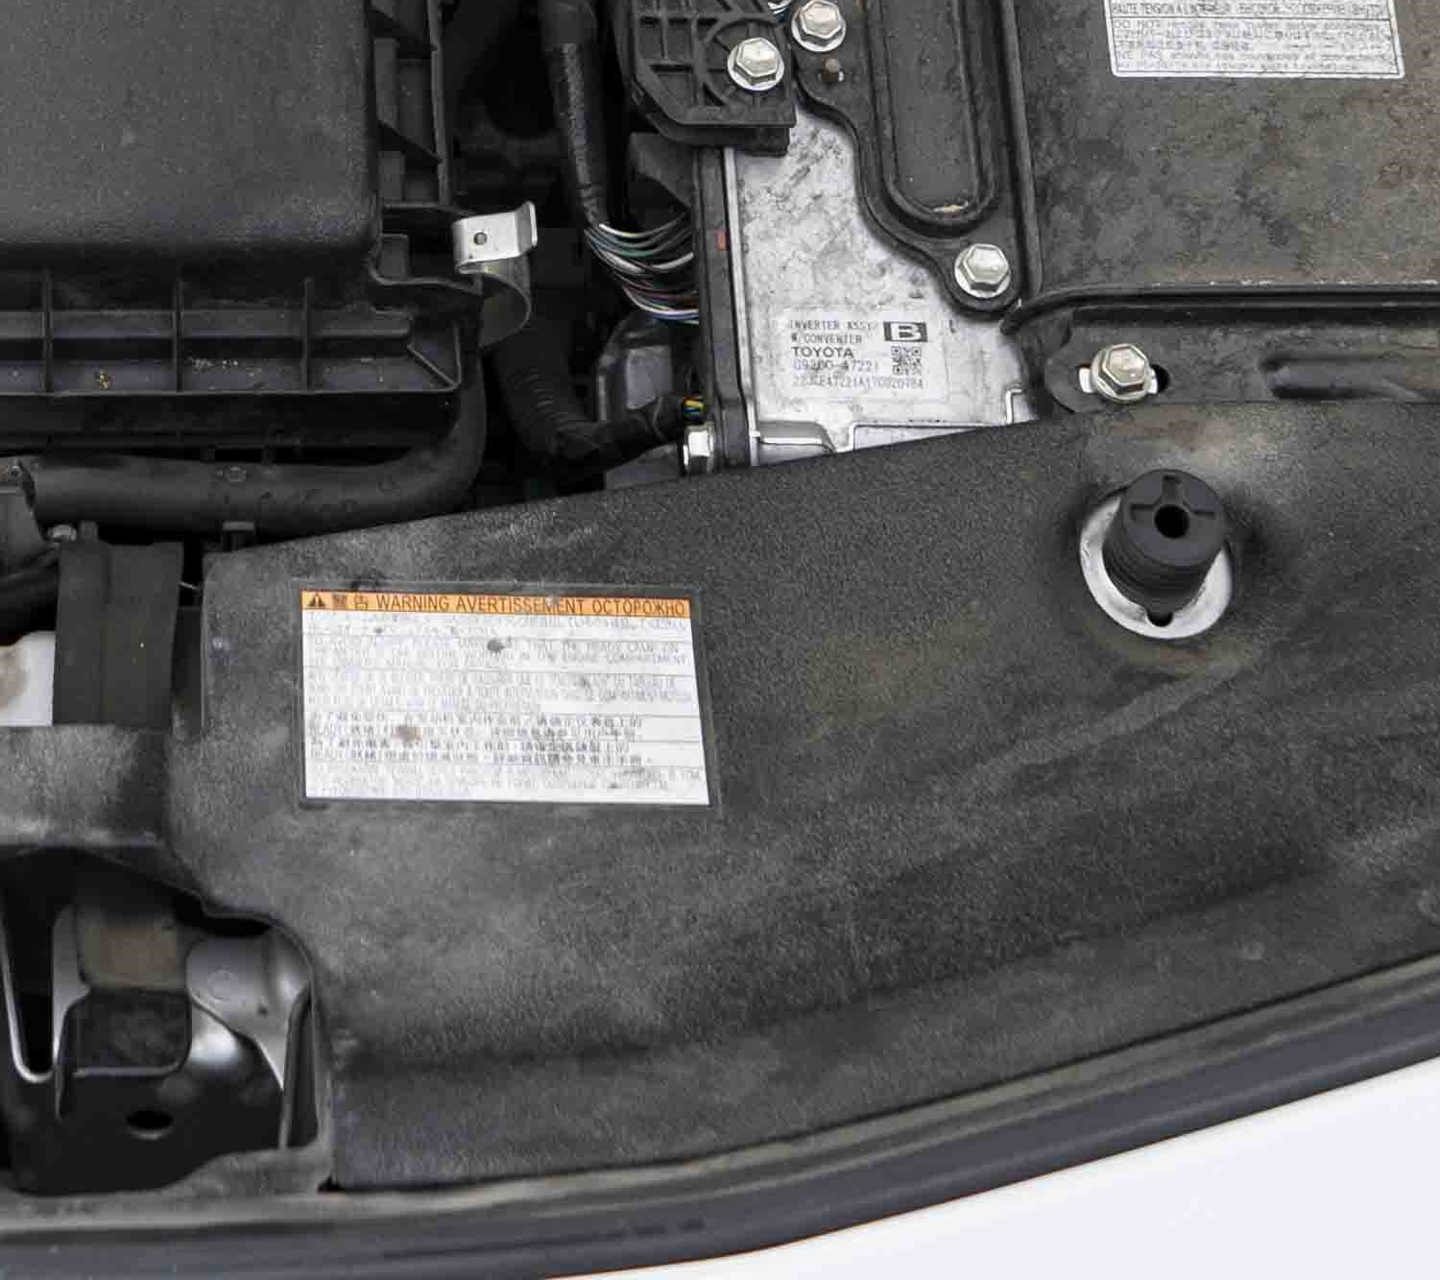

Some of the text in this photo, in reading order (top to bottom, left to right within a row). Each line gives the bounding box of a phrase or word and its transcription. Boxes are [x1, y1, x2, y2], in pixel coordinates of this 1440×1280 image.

[791, 346, 855, 358] TOYOTA
[375, 593, 584, 614] WARNING AVERTISSEMENT
